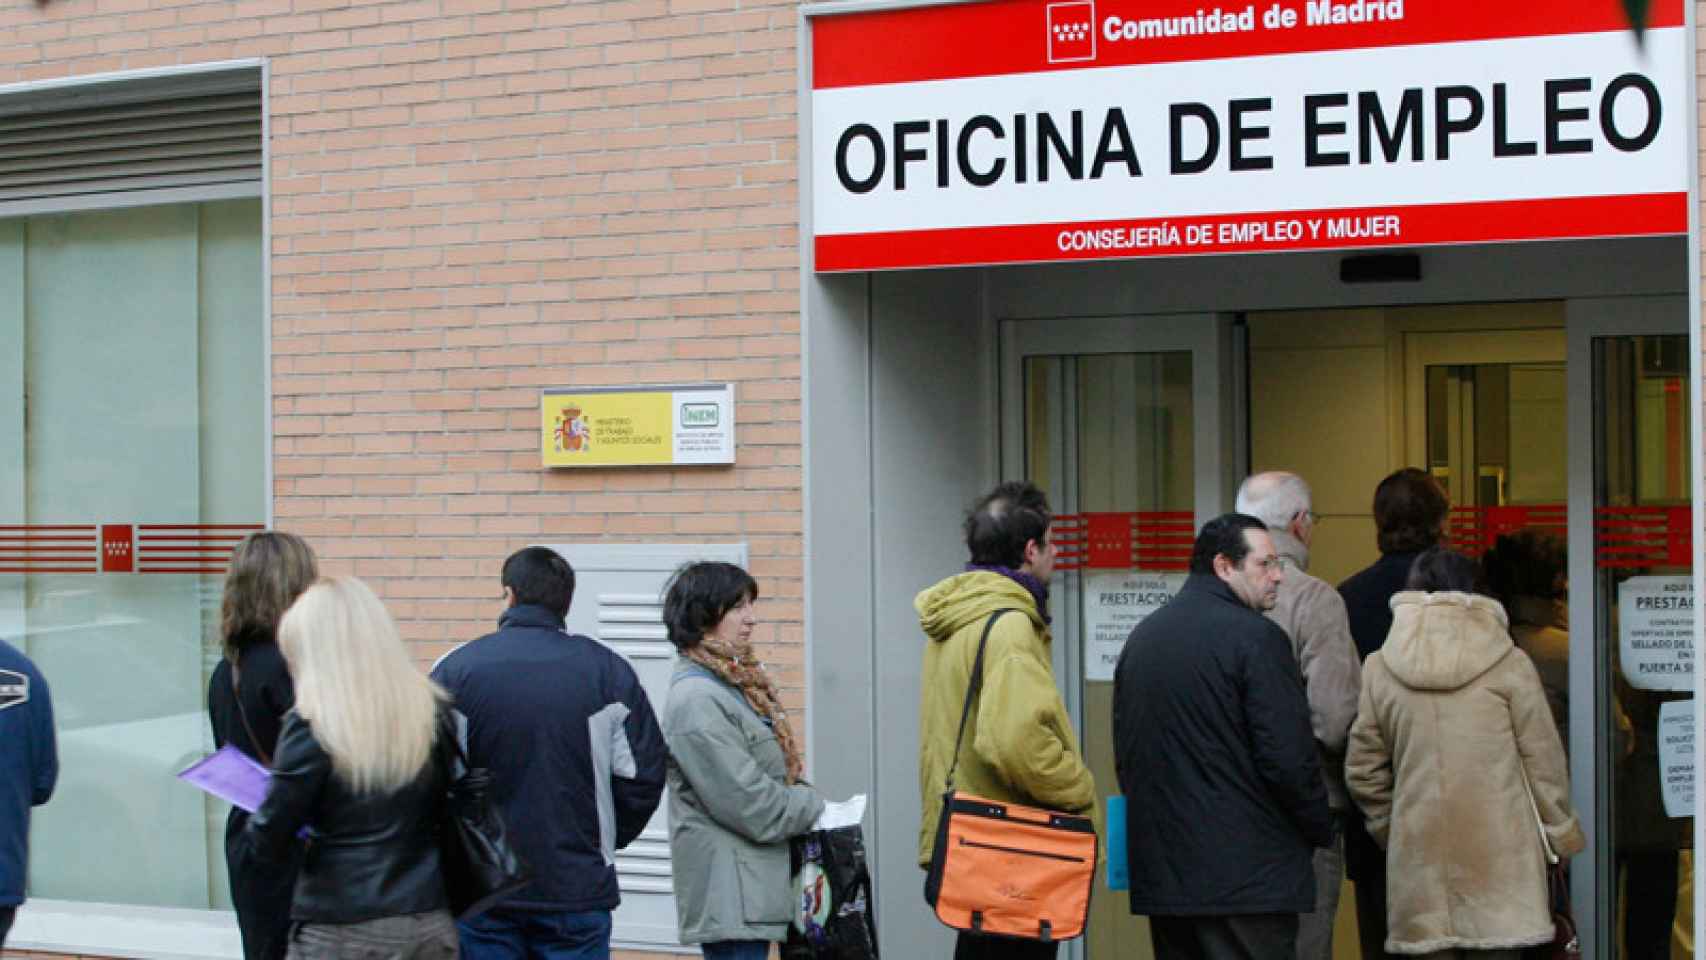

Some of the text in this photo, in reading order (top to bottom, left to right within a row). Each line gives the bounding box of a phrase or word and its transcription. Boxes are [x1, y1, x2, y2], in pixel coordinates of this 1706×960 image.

[1103, 0, 1404, 41] Comunidad de Madrid
[835, 73, 1662, 194] OFICINA DE EMPLEO
[1057, 215, 1401, 250] CONSEJERÍA DE EMPLEO Y MUJER
